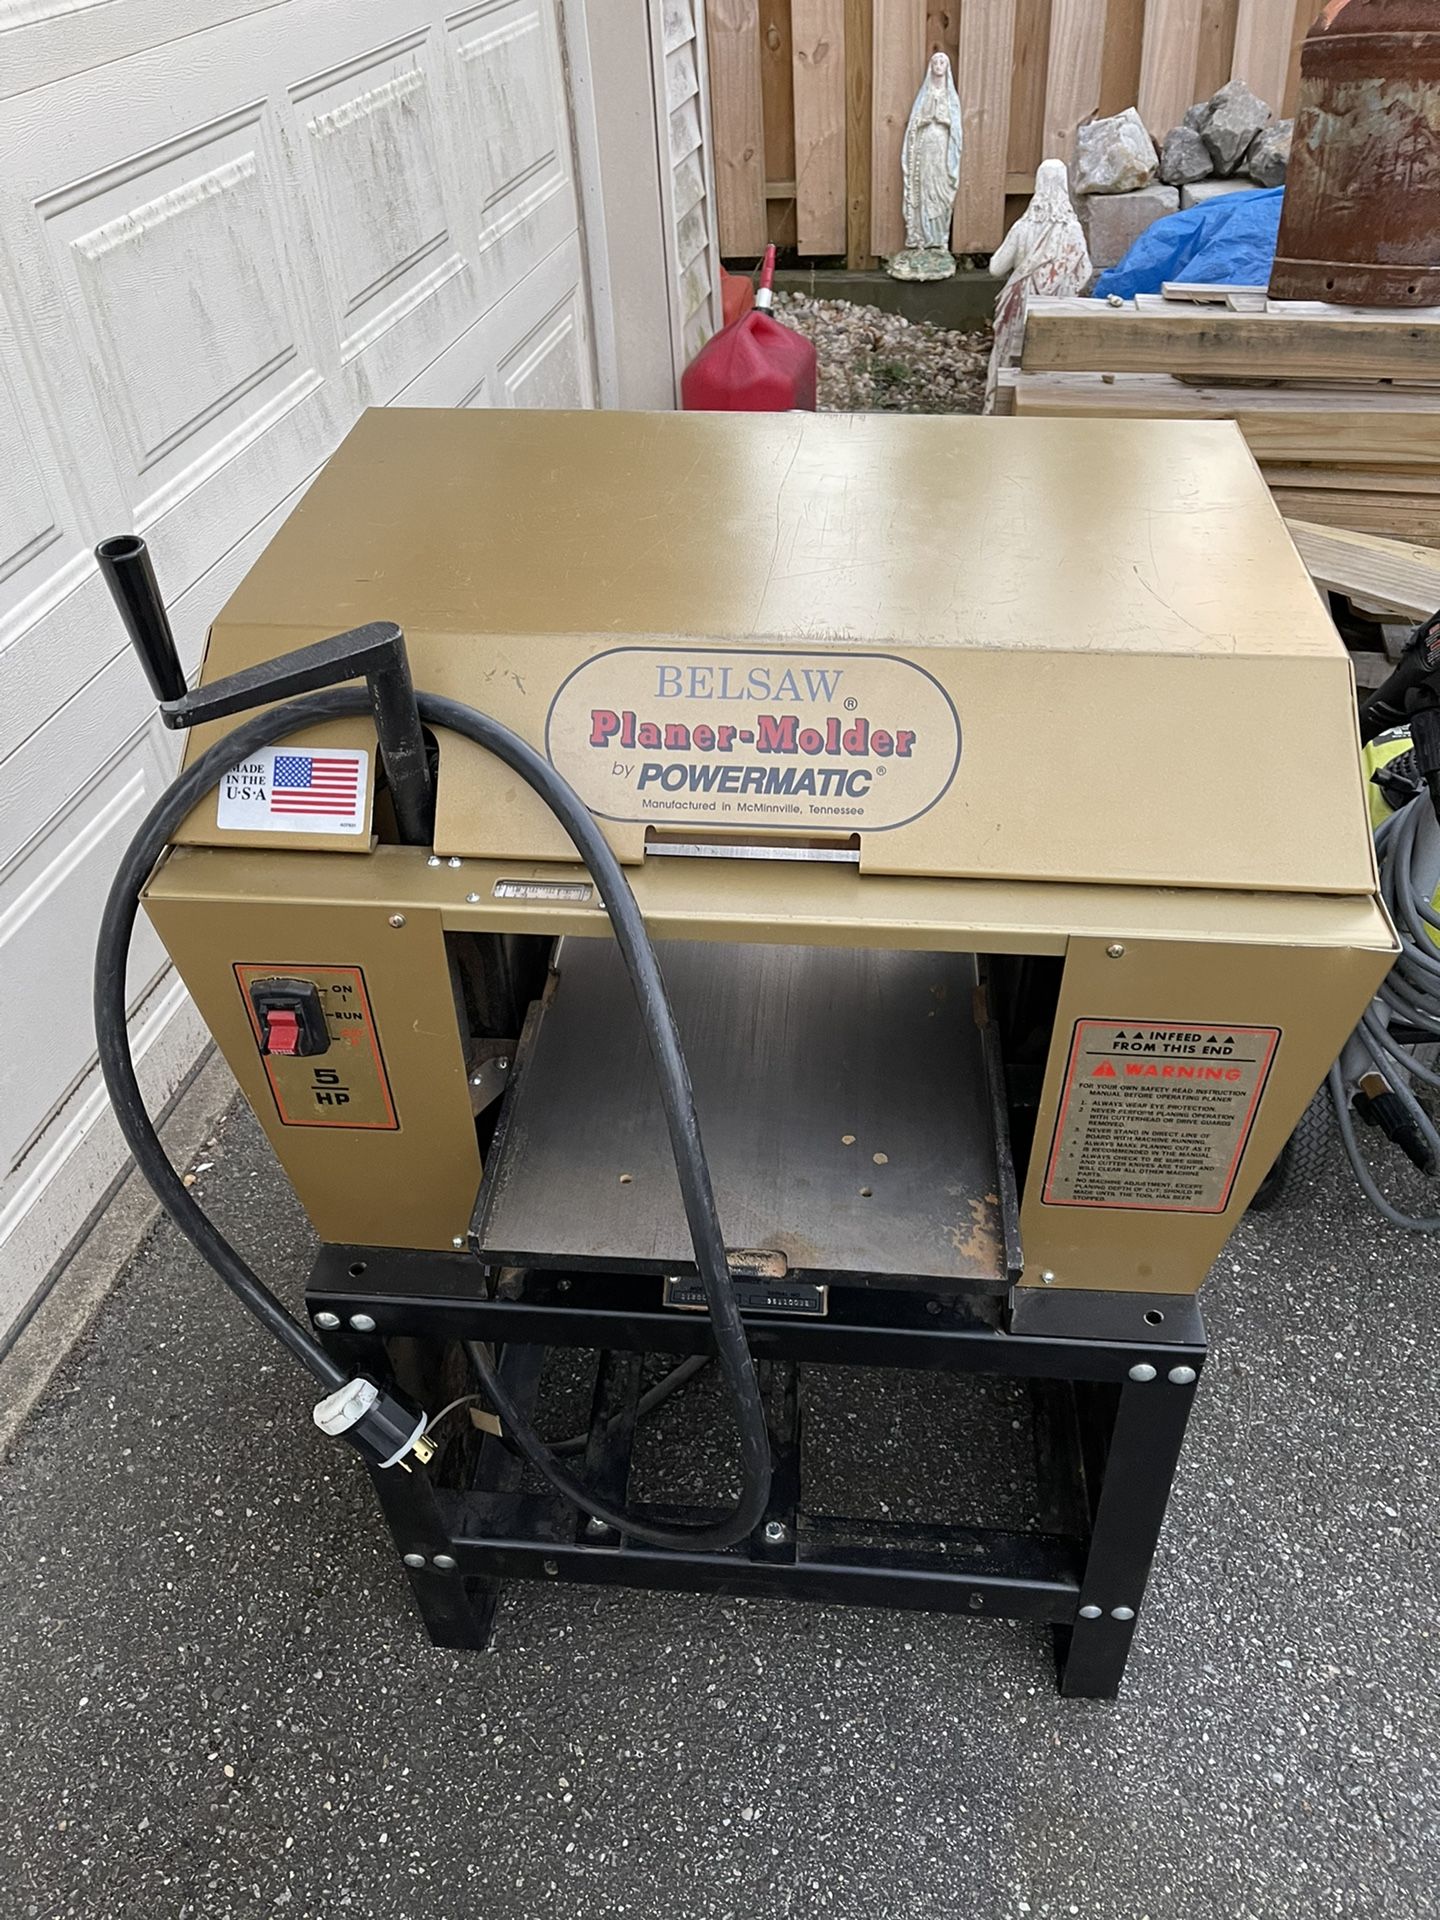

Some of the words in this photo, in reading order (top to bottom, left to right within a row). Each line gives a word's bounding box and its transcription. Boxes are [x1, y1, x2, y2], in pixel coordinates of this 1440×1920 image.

[588, 709, 916, 758] Planer-Molder
[230, 763, 265, 774] MADE
[226, 775, 240, 785] IN
[243, 775, 267, 785] THE
[611, 761, 636, 778] by
[636, 762, 872, 797] POWERMATIC
[642, 799, 717, 812] Manufactured
[722, 801, 732, 812] in
[736, 801, 803, 815] McMinnville,
[808, 804, 865, 816] Tennessee
[331, 985, 353, 993] ON
[335, 1012, 363, 1020] RUN
[1150, 1031, 1202, 1042] INFEED
[1112, 1042, 1156, 1052] FROM
[1163, 1044, 1196, 1054] THIS
[1202, 1046, 1234, 1056] END
[314, 1068, 340, 1085] 5
[1124, 1063, 1242, 1082] WARNING
[316, 1092, 350, 1106] HP
[1092, 1147, 1149, 1155] RECOMMENDED
